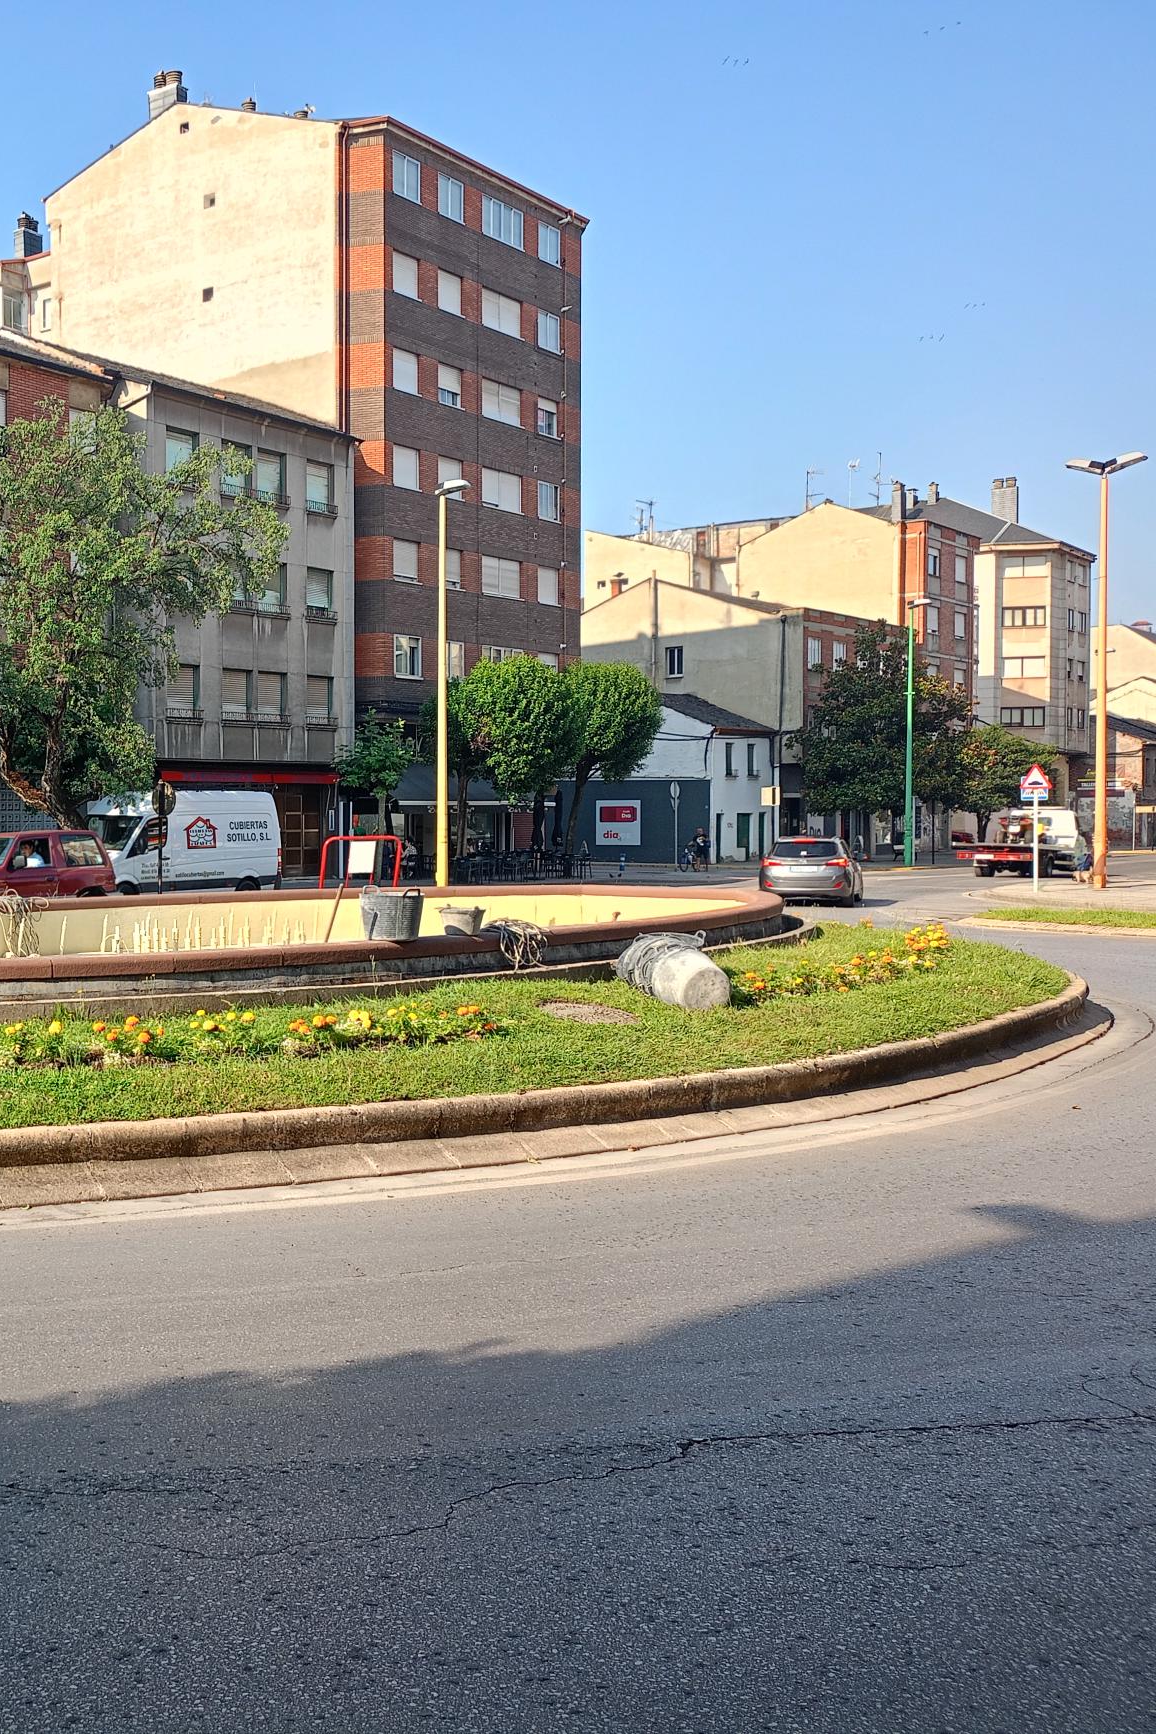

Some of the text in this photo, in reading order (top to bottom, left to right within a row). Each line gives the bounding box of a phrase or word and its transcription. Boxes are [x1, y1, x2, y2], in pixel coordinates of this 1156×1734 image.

[229, 821, 268, 830] CUBIERTAS
[227, 832, 272, 843] SOTILLO, S.L.
[603, 830, 619, 839] dia
